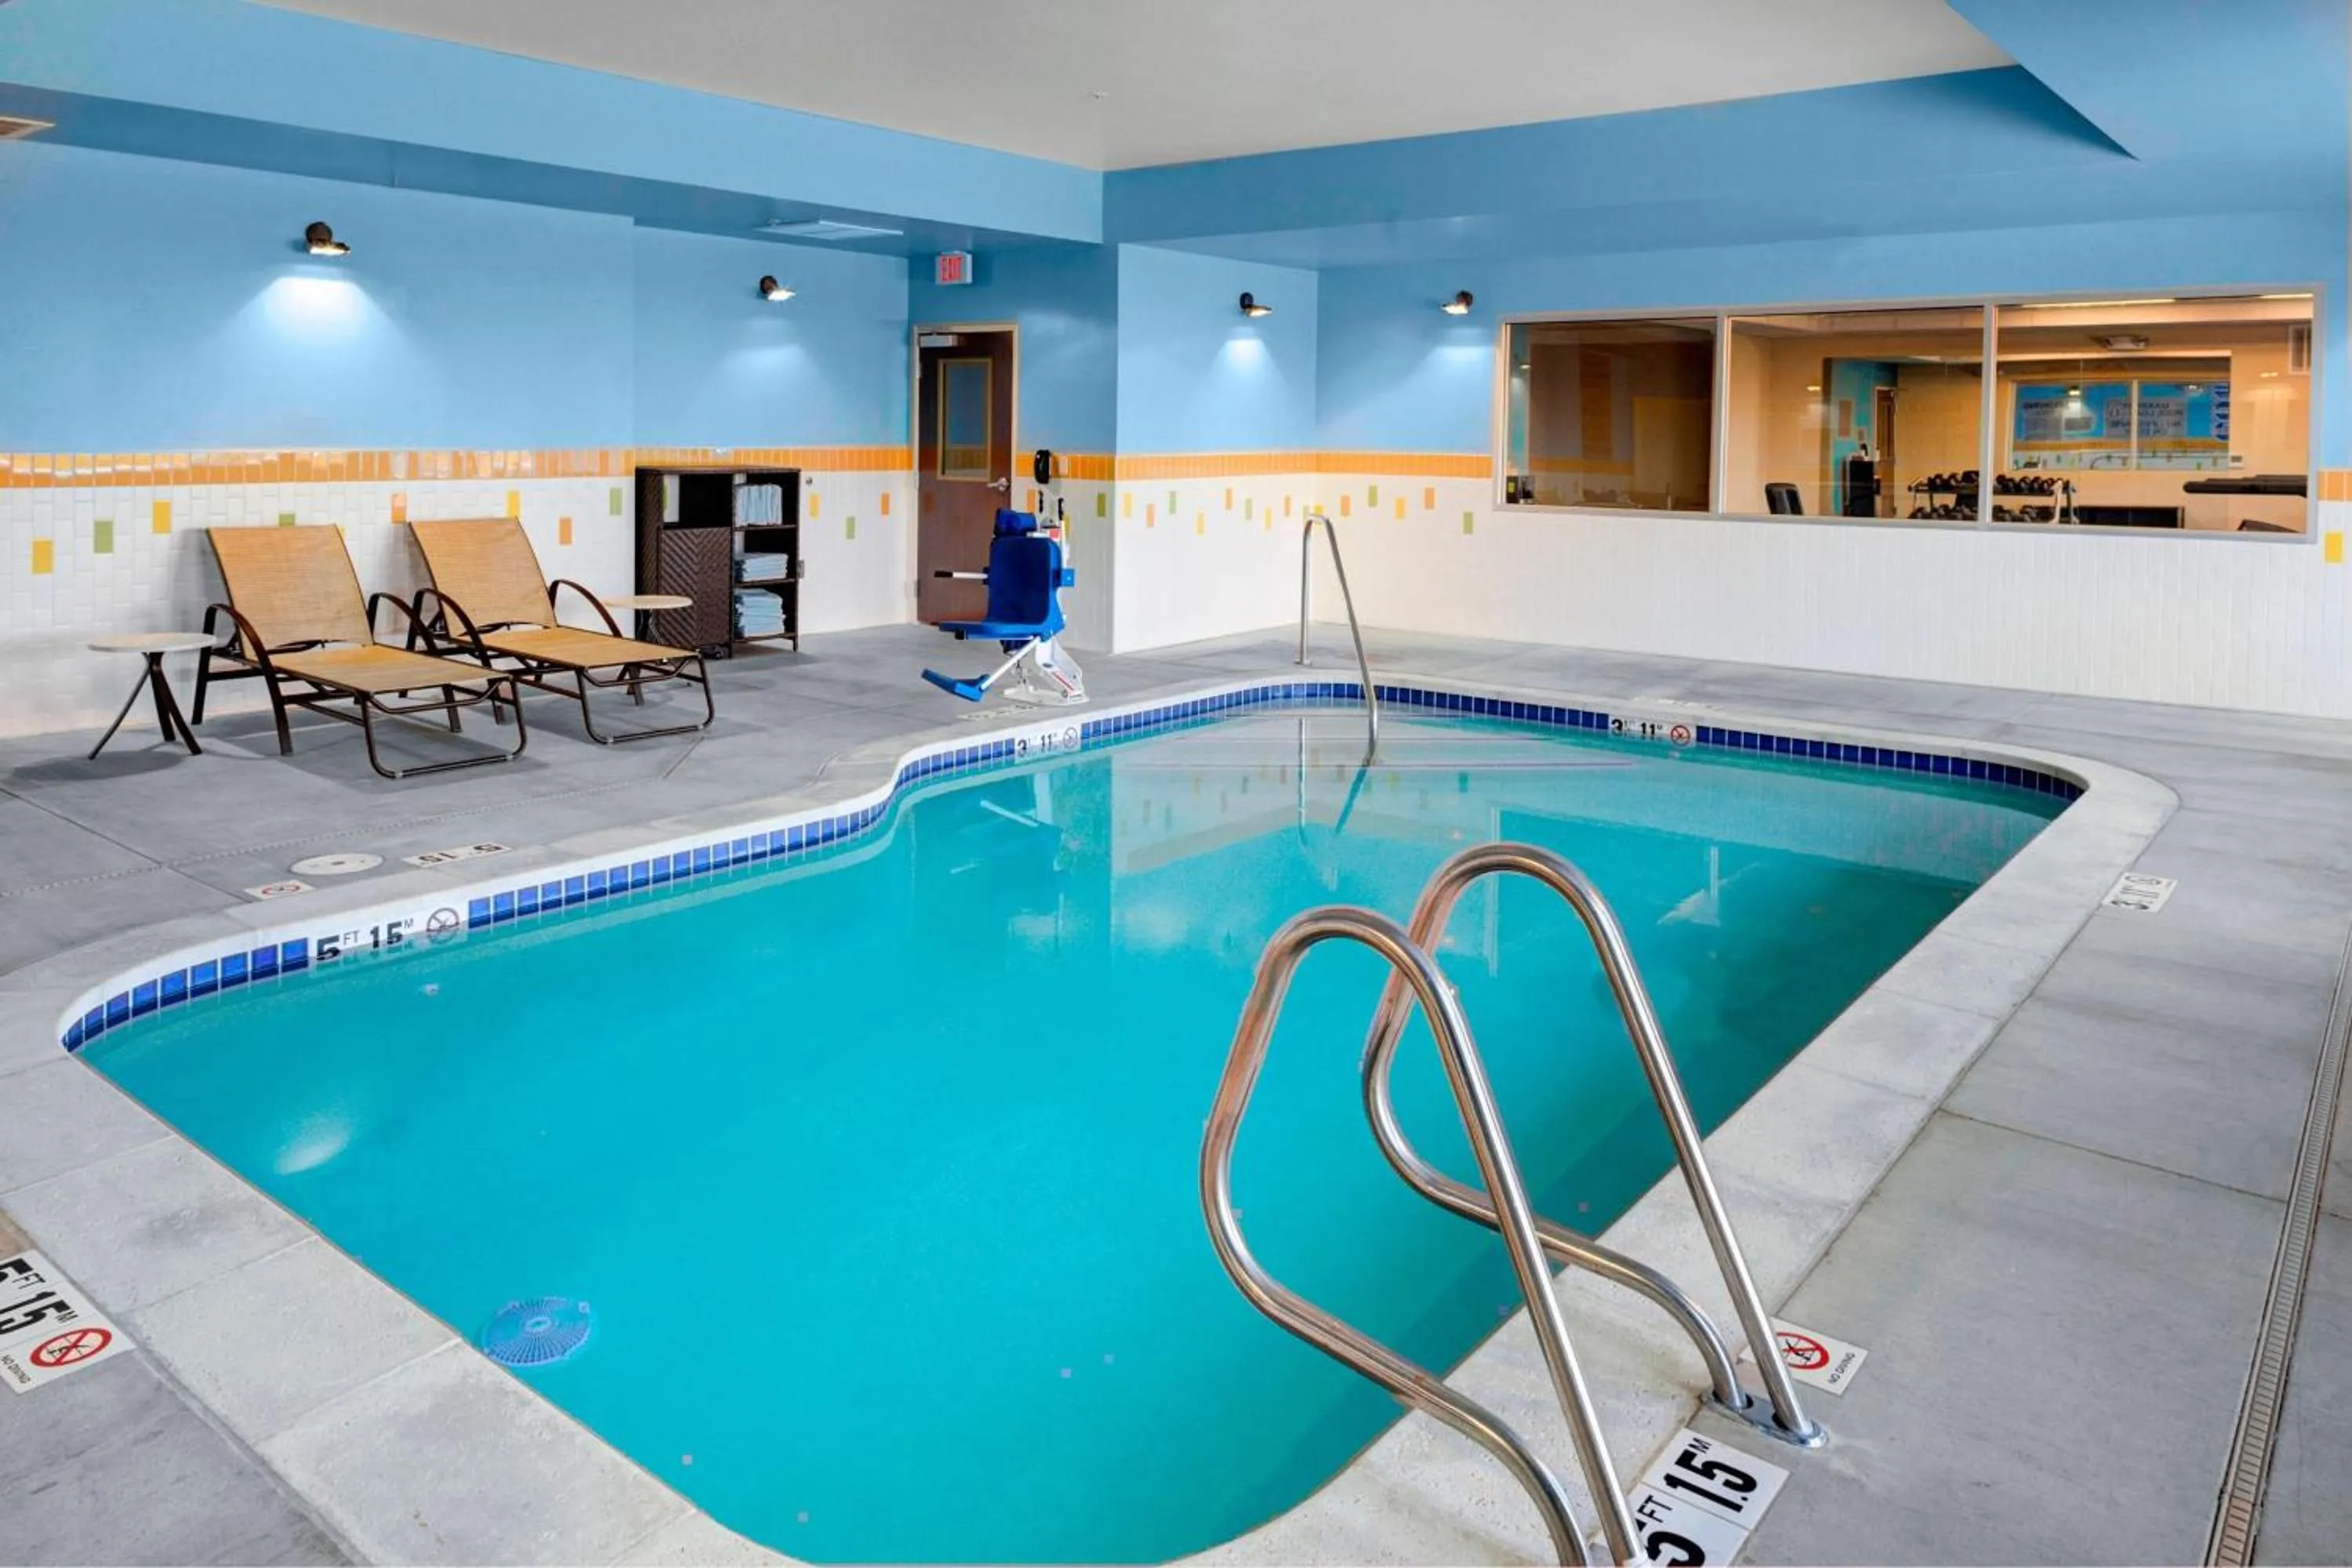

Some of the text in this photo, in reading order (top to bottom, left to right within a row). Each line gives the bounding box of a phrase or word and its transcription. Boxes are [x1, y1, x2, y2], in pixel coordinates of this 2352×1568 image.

[941, 256, 961, 282] EXIT
[317, 935, 340, 960] 5
[343, 931, 358, 946] FT
[1828, 1352, 1856, 1384] NO DIVING
[1687, 1437, 1712, 1454] M
[1663, 1449, 1758, 1513] 1.5
[1637, 1494, 1673, 1523] FT
